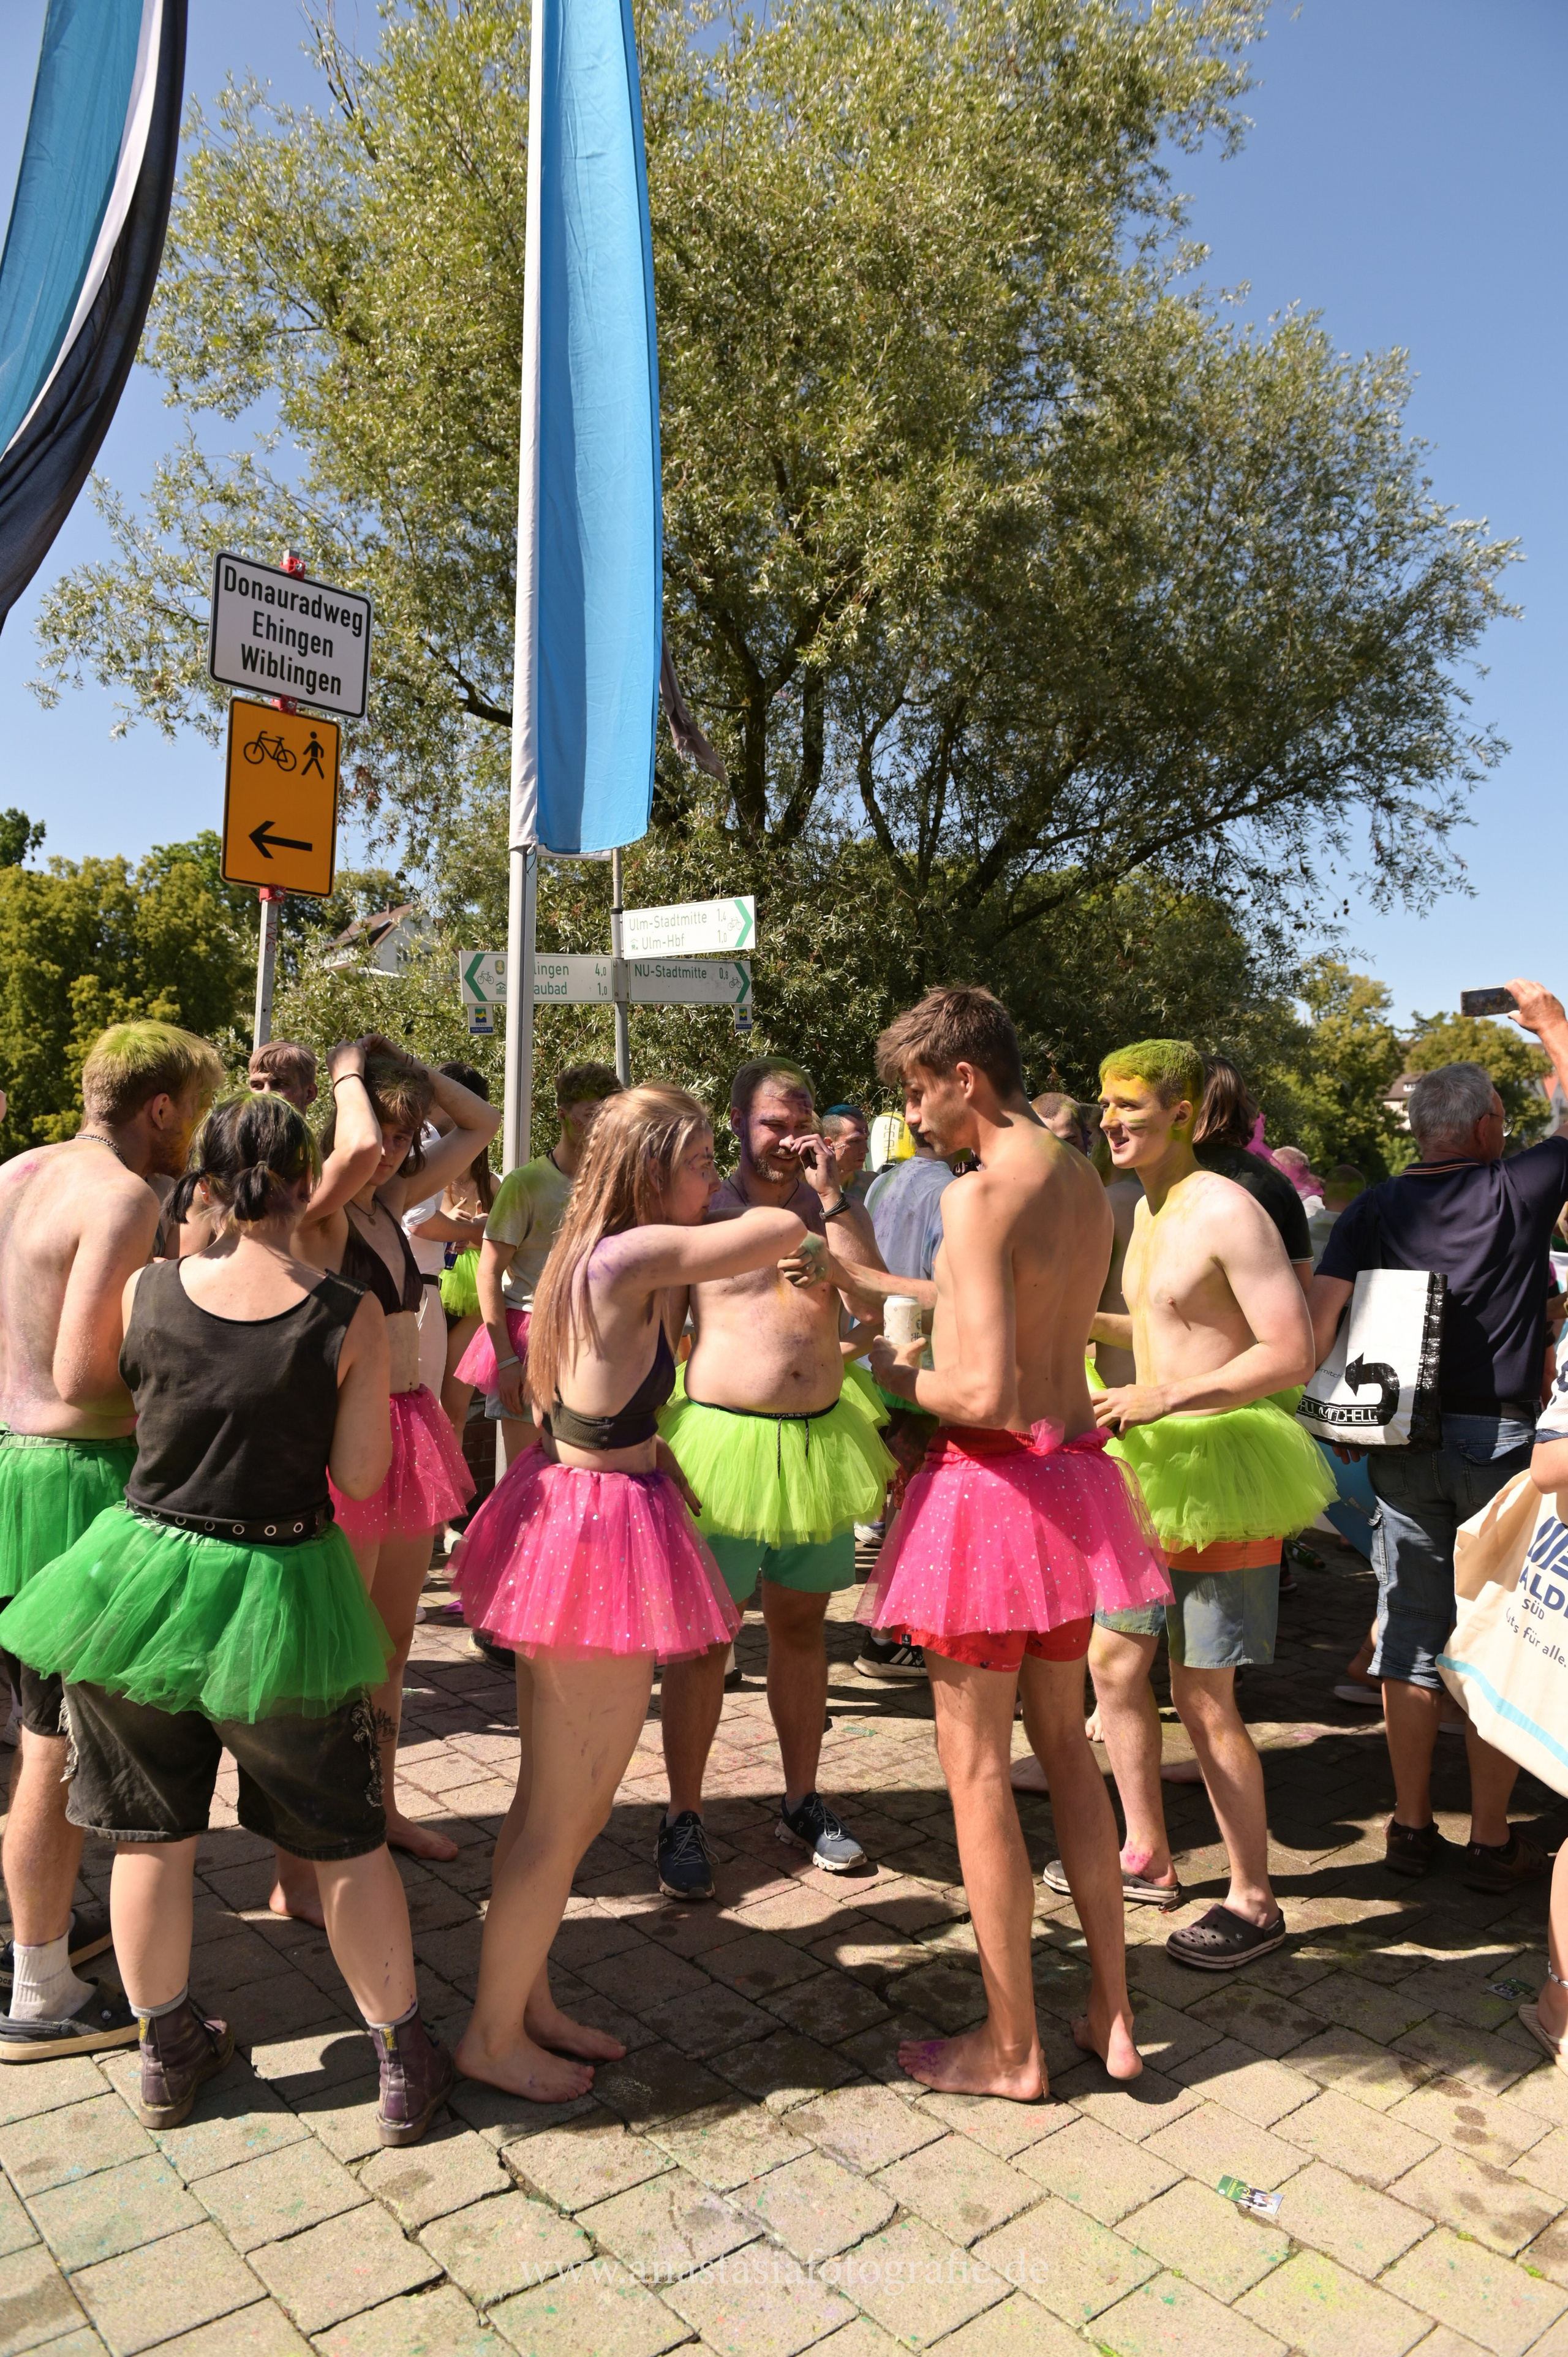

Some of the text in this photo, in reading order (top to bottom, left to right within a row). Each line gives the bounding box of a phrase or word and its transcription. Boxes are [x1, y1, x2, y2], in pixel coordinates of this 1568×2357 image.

[224, 565, 363, 637] Donauradweg
[252, 611, 333, 658] Ehingen
[241, 643, 341, 695] Wiblingen
[629, 908, 726, 931] Ulm-Stadtmitte 1,4
[642, 930, 727, 950] Ulm-Hbf 1,0
[534, 962, 607, 978] lingen 4,0
[635, 964, 729, 980] NU-Stadtmitte 0,8
[534, 981, 608, 996] aubad 1,0
[1319, 1406, 1378, 1422] MITCHELL
[1521, 1598, 1545, 1620] SÜD
[1523, 1627, 1540, 1647] für
[1542, 1645, 1567, 1668] alle.
